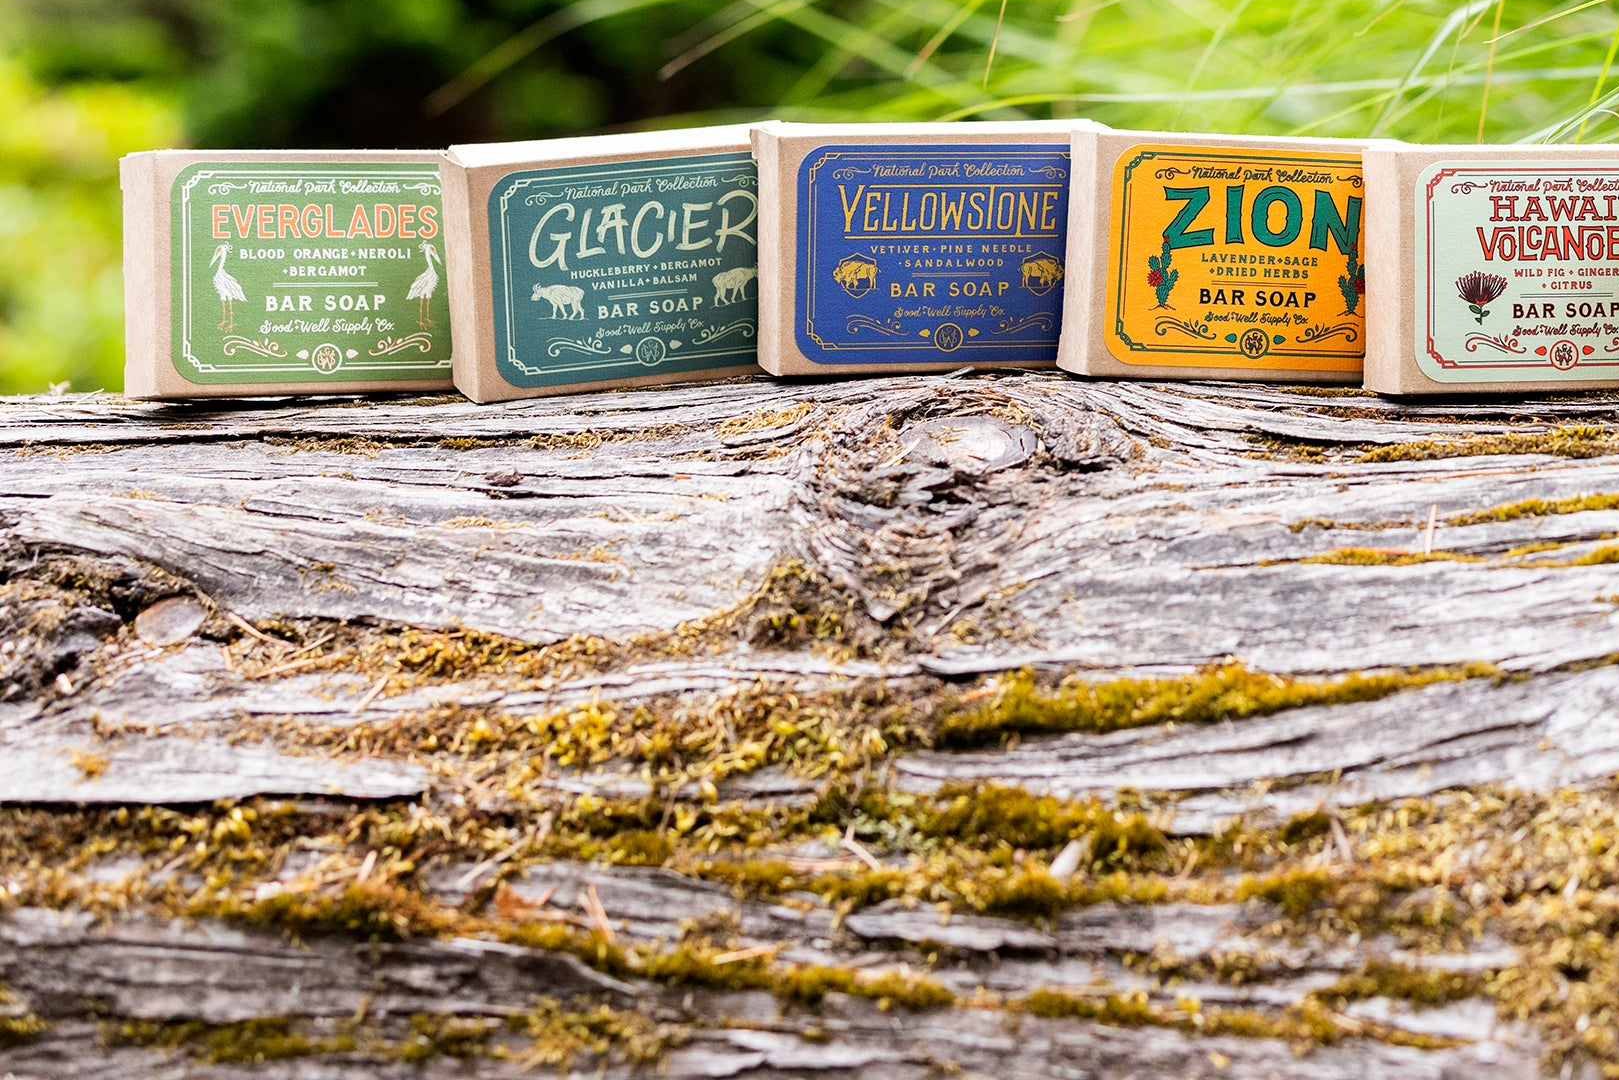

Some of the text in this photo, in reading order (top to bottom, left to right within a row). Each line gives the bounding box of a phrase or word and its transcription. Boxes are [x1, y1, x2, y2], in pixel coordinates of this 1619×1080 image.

[872, 163, 1025, 179] National Park Collection
[1191, 166, 1334, 184] National Park Collection
[249, 180, 400, 195] National Park Collection
[564, 176, 718, 200] National Park Collection
[1490, 179, 1540, 192] National
[1543, 178, 1573, 194] Park
[838, 184, 1063, 238] YELLOWSTONE
[212, 204, 438, 238] EVERGLADES
[1163, 184, 1363, 255] ZION
[528, 190, 758, 270] GLACIER
[240, 249, 411, 259] BLOOD ORANGE NEROLI
[870, 244, 1032, 254] VETIVER PINE NEEDLE
[905, 258, 1004, 268] SANDALWOOD
[1201, 253, 1318, 267] LAVENDER SAGE
[289, 266, 367, 276] BERGAMOT
[570, 258, 722, 279] HUCKLEBERRY BERGAMOT
[1216, 268, 1309, 279] DRIED HERBS
[1514, 268, 1619, 277] WILD FIG GINGER
[592, 274, 698, 290] VANILLA BALSAM
[890, 282, 1010, 298] BAR SOAP
[1551, 281, 1592, 290] CITRUS
[265, 295, 386, 312] BAR SOAP
[1199, 289, 1317, 308] BAR SOAP
[598, 296, 703, 319] BAR SOAP
[953, 305, 987, 318] Supply
[989, 305, 1005, 316] Co.
[1513, 303, 1556, 319] BAR
[333, 319, 372, 335] Supply
[375, 319, 394, 331] Co.
[654, 320, 686, 334] Supply
[688, 318, 704, 328] Co.
[1260, 313, 1291, 325] Supply
[1293, 314, 1308, 324] Co.
[1570, 323, 1602, 337] Supply
[1603, 323, 1619, 334] Co.
